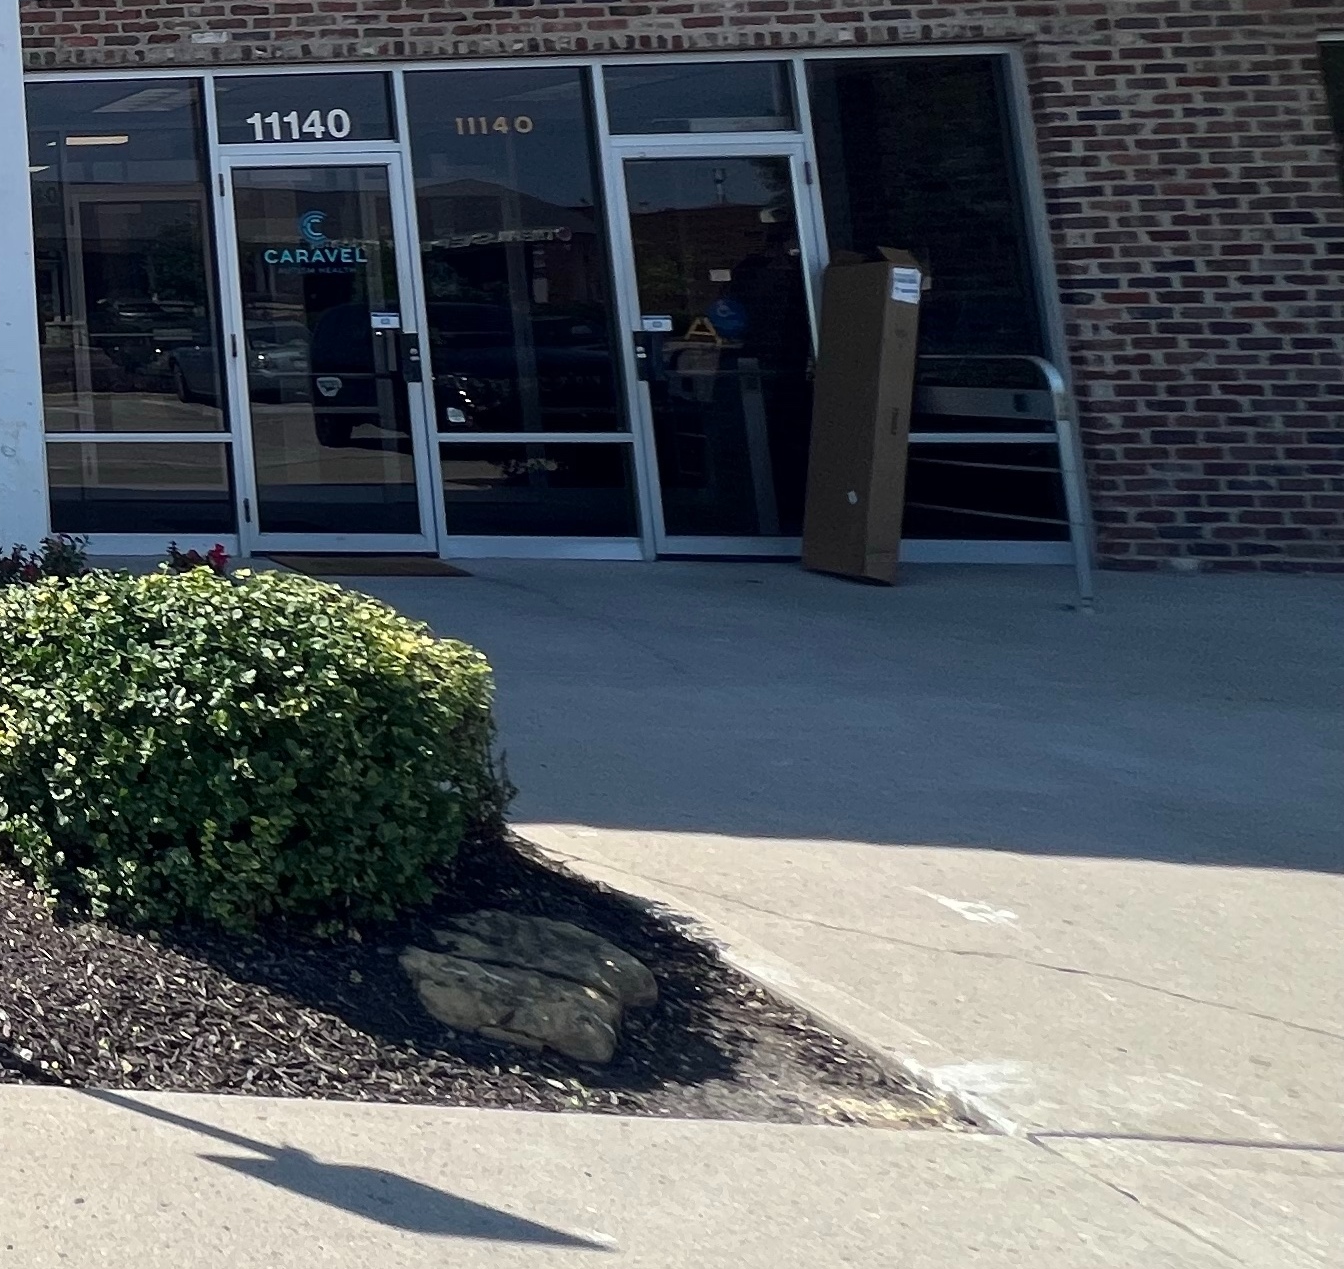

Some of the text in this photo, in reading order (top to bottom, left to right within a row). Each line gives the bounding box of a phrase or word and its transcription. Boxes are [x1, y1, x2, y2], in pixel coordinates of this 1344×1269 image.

[245, 108, 351, 141] 11140
[454, 115, 534, 135] 11140
[263, 247, 369, 264] CARAVEL
